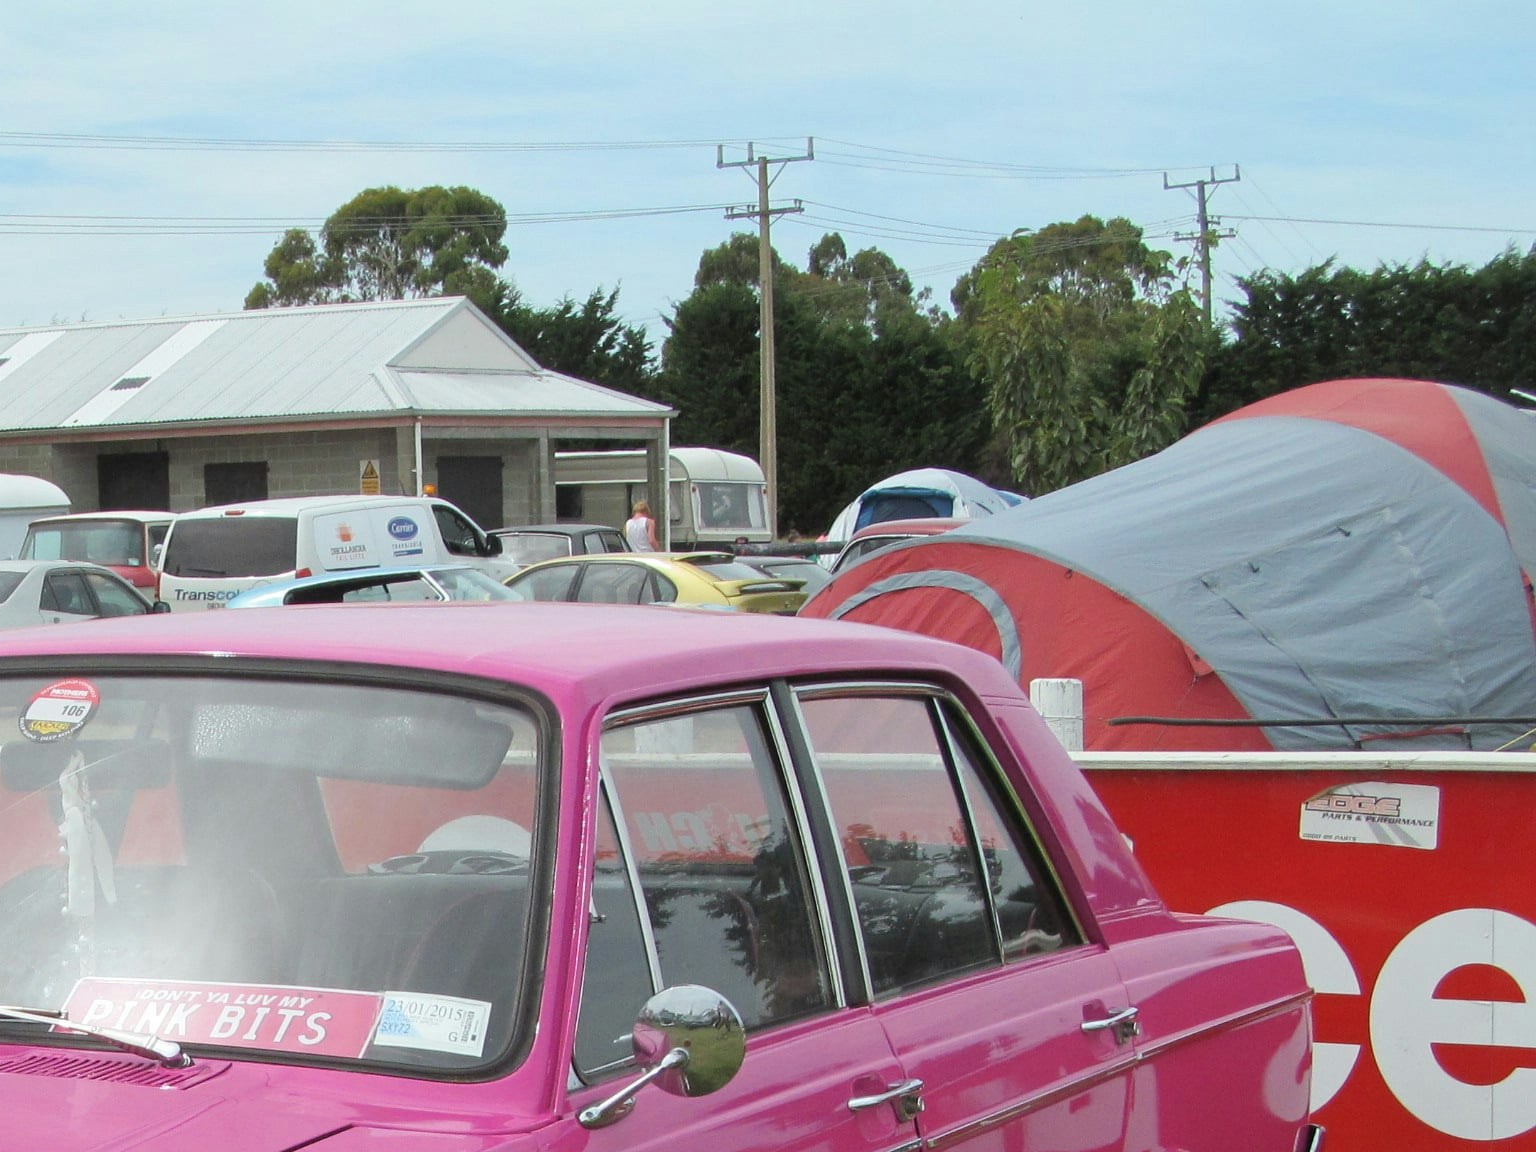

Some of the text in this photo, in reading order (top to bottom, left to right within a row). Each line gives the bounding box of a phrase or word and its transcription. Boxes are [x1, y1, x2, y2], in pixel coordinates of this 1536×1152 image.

[391, 522, 414, 534] Carrier
[61, 704, 86, 717] 106
[1305, 793, 1401, 818] EDGE
[1321, 812, 1353, 822] PARTS
[1365, 815, 1435, 828] PERFORMANCE
[138, 989, 314, 1010] DON'T YA LUV MY
[387, 999, 464, 1021] 23/01/2015
[81, 999, 332, 1047] PINK BITS
[381, 1021, 411, 1034] SXY72
[448, 1031, 459, 1042] G
